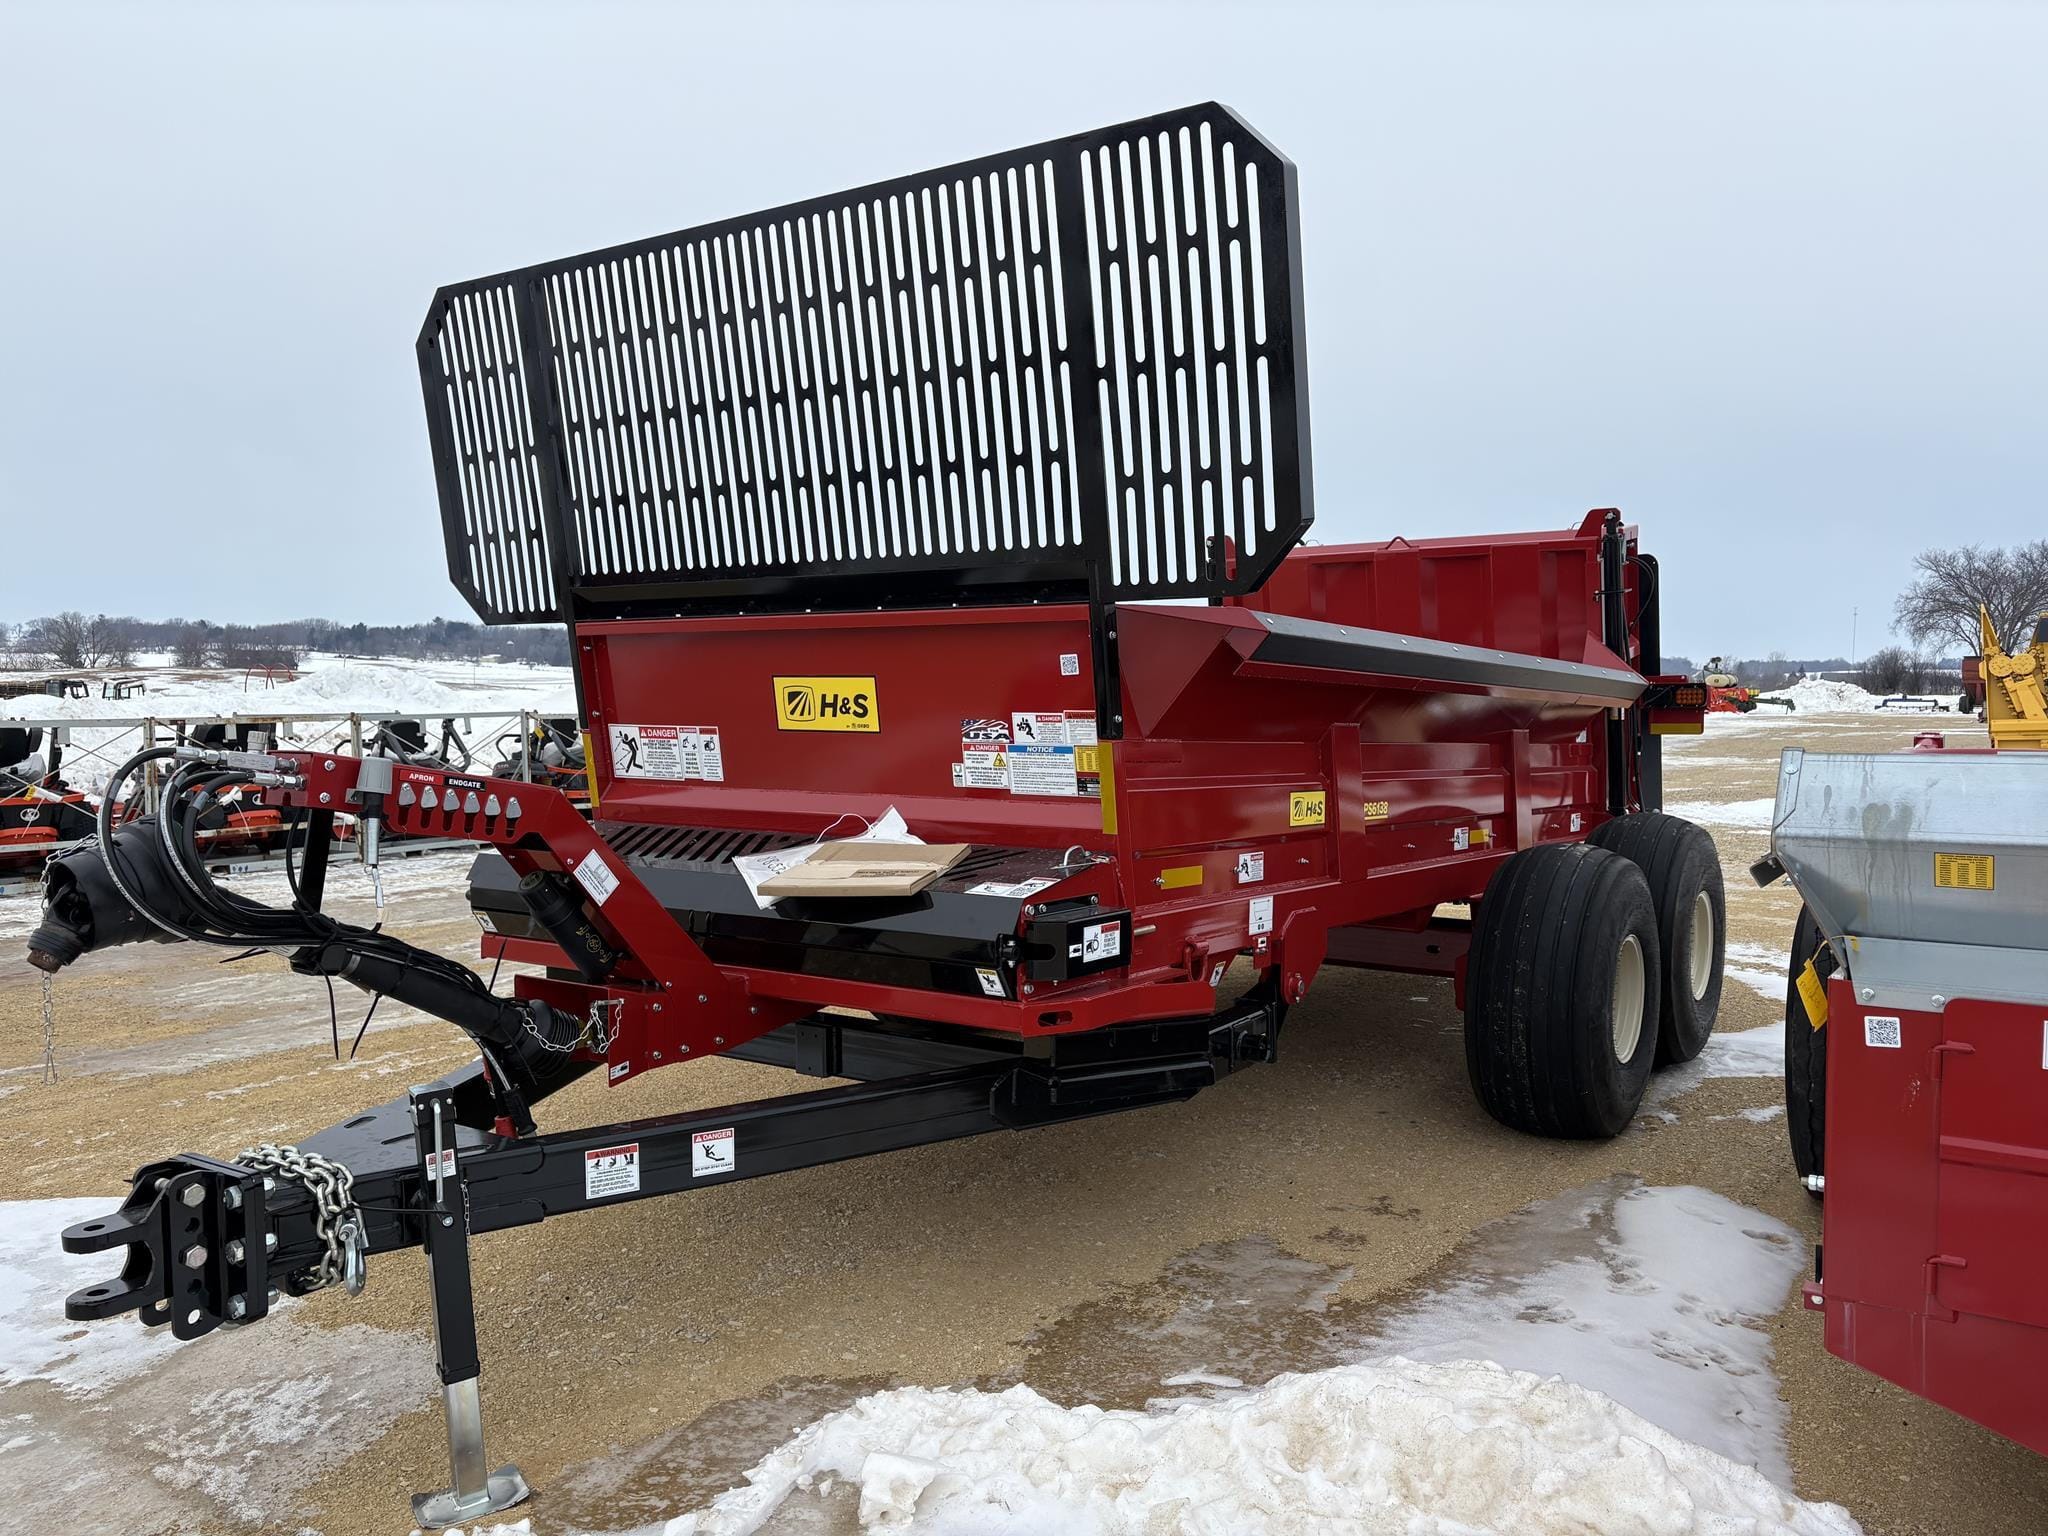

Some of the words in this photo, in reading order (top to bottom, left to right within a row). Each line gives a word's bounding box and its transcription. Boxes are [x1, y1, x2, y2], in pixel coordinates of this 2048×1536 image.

[820, 693, 869, 719] H&S
[647, 728, 678, 738] DANGER
[964, 732, 1011, 740] USA
[409, 773, 435, 782] APRON
[448, 778, 481, 789] ENDGATE
[1305, 801, 1323, 817] H&S
[702, 1130, 732, 1141] DANGER
[600, 1147, 631, 1158] WARNING
